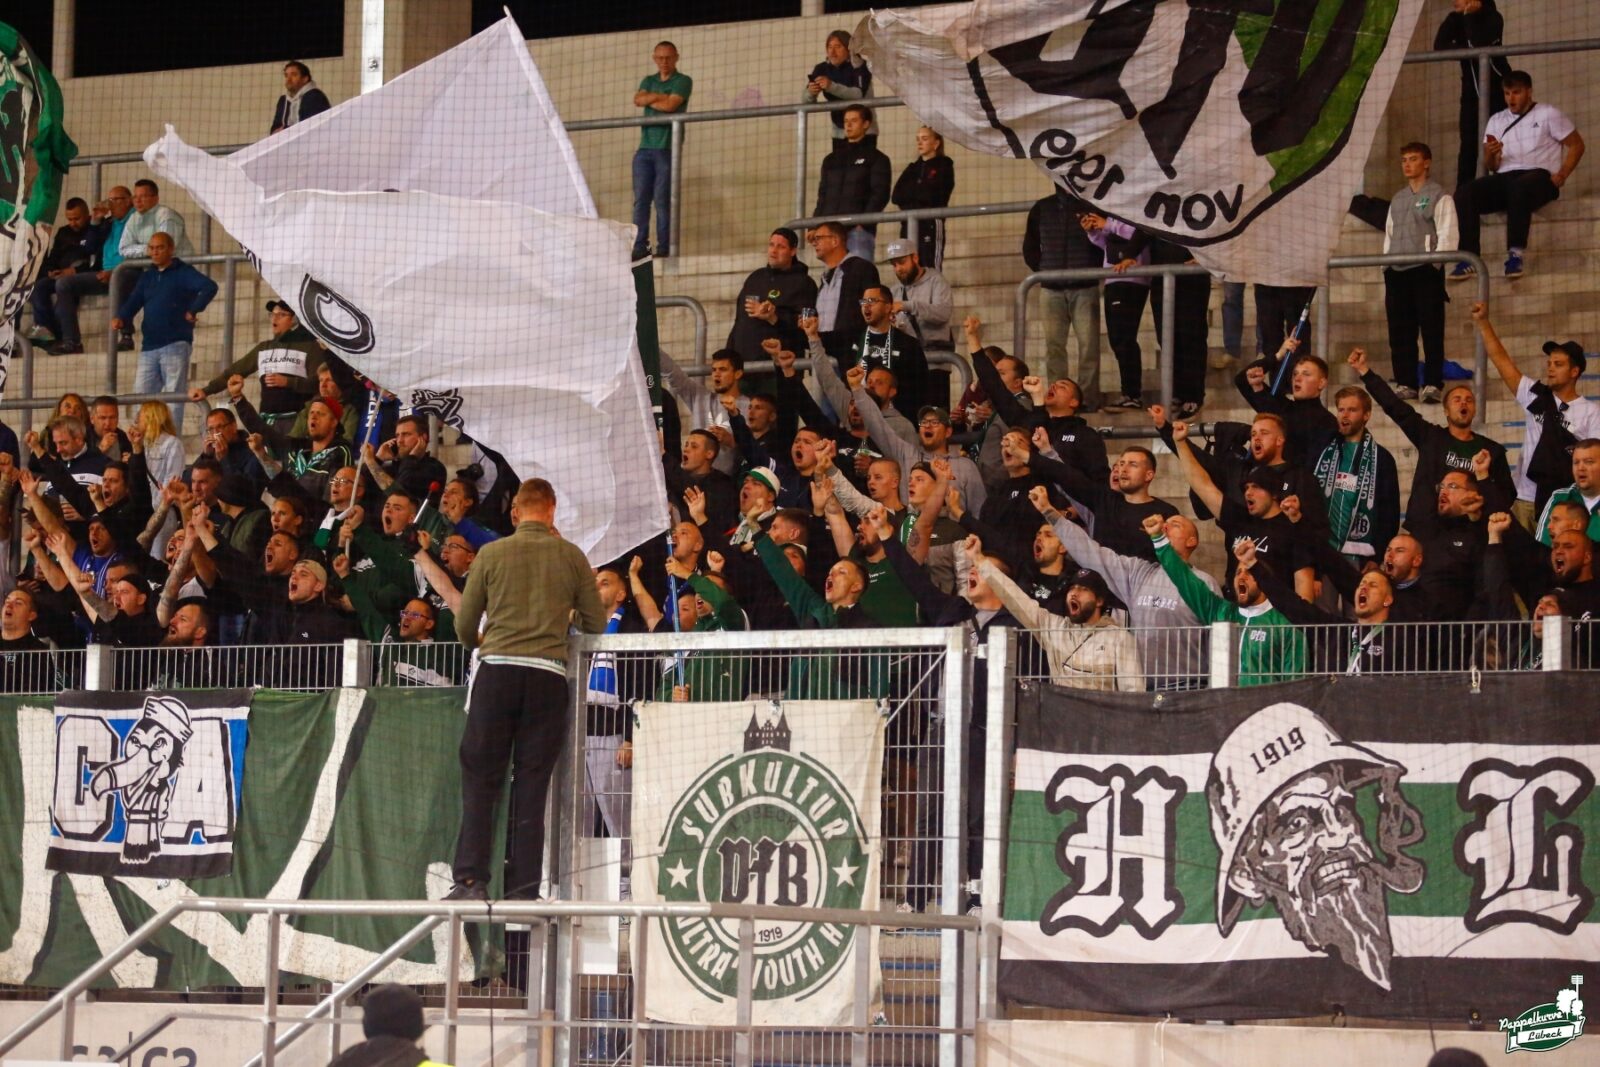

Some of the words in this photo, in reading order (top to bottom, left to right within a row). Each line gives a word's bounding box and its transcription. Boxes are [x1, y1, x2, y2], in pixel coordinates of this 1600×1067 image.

[1250, 727, 1306, 774] 1919
[681, 758, 850, 845] SUBKULTUR
[758, 927, 784, 943] 1919
[819, 921, 850, 947] H
